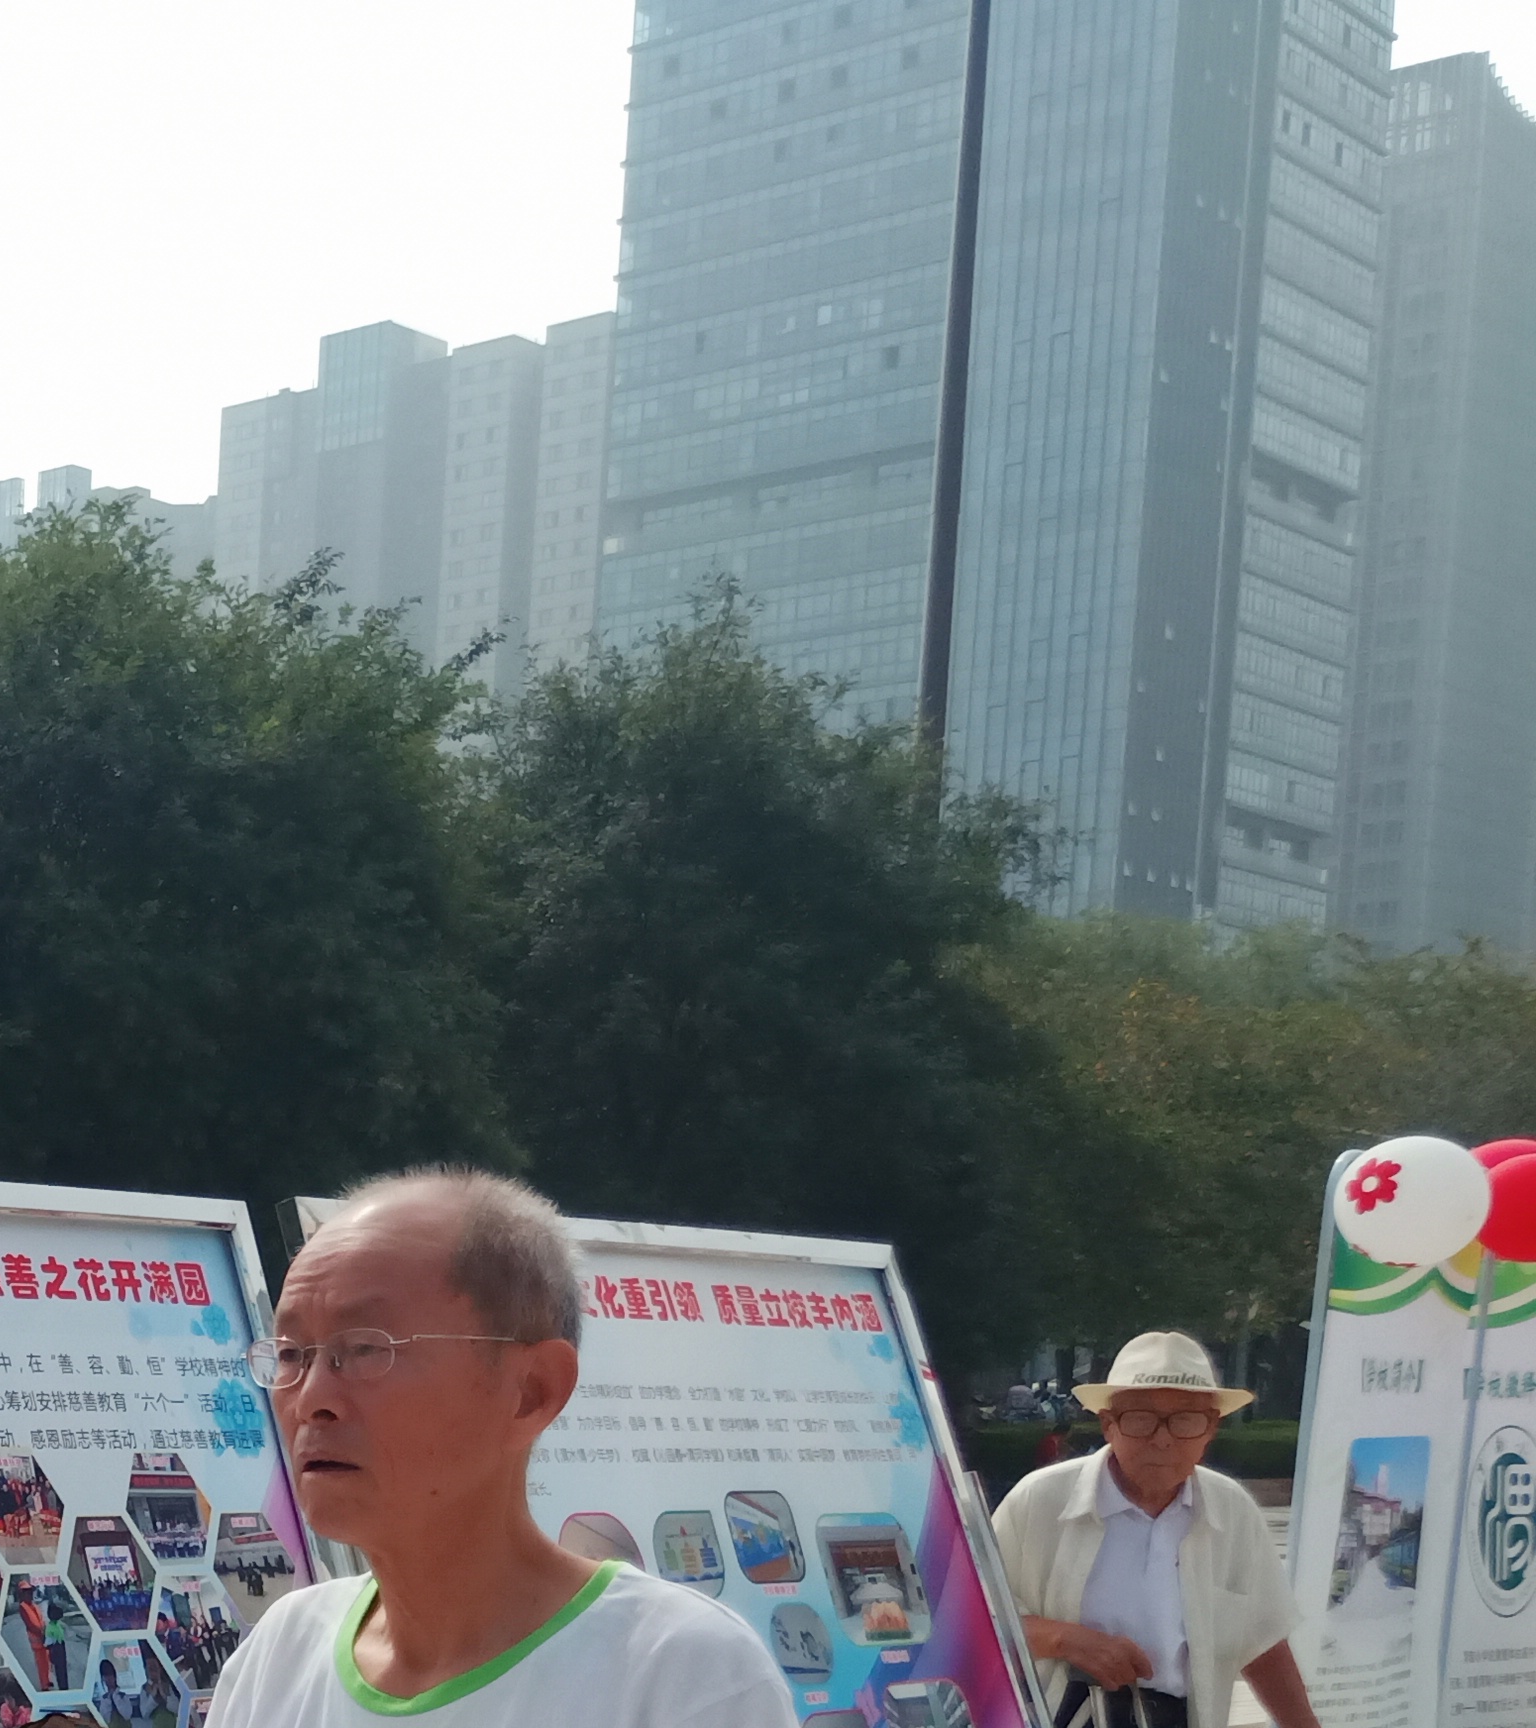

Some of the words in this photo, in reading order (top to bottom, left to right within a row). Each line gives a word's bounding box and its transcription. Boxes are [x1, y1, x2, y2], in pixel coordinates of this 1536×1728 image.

[710, 1284, 883, 1332] 质量立校丰内涵
